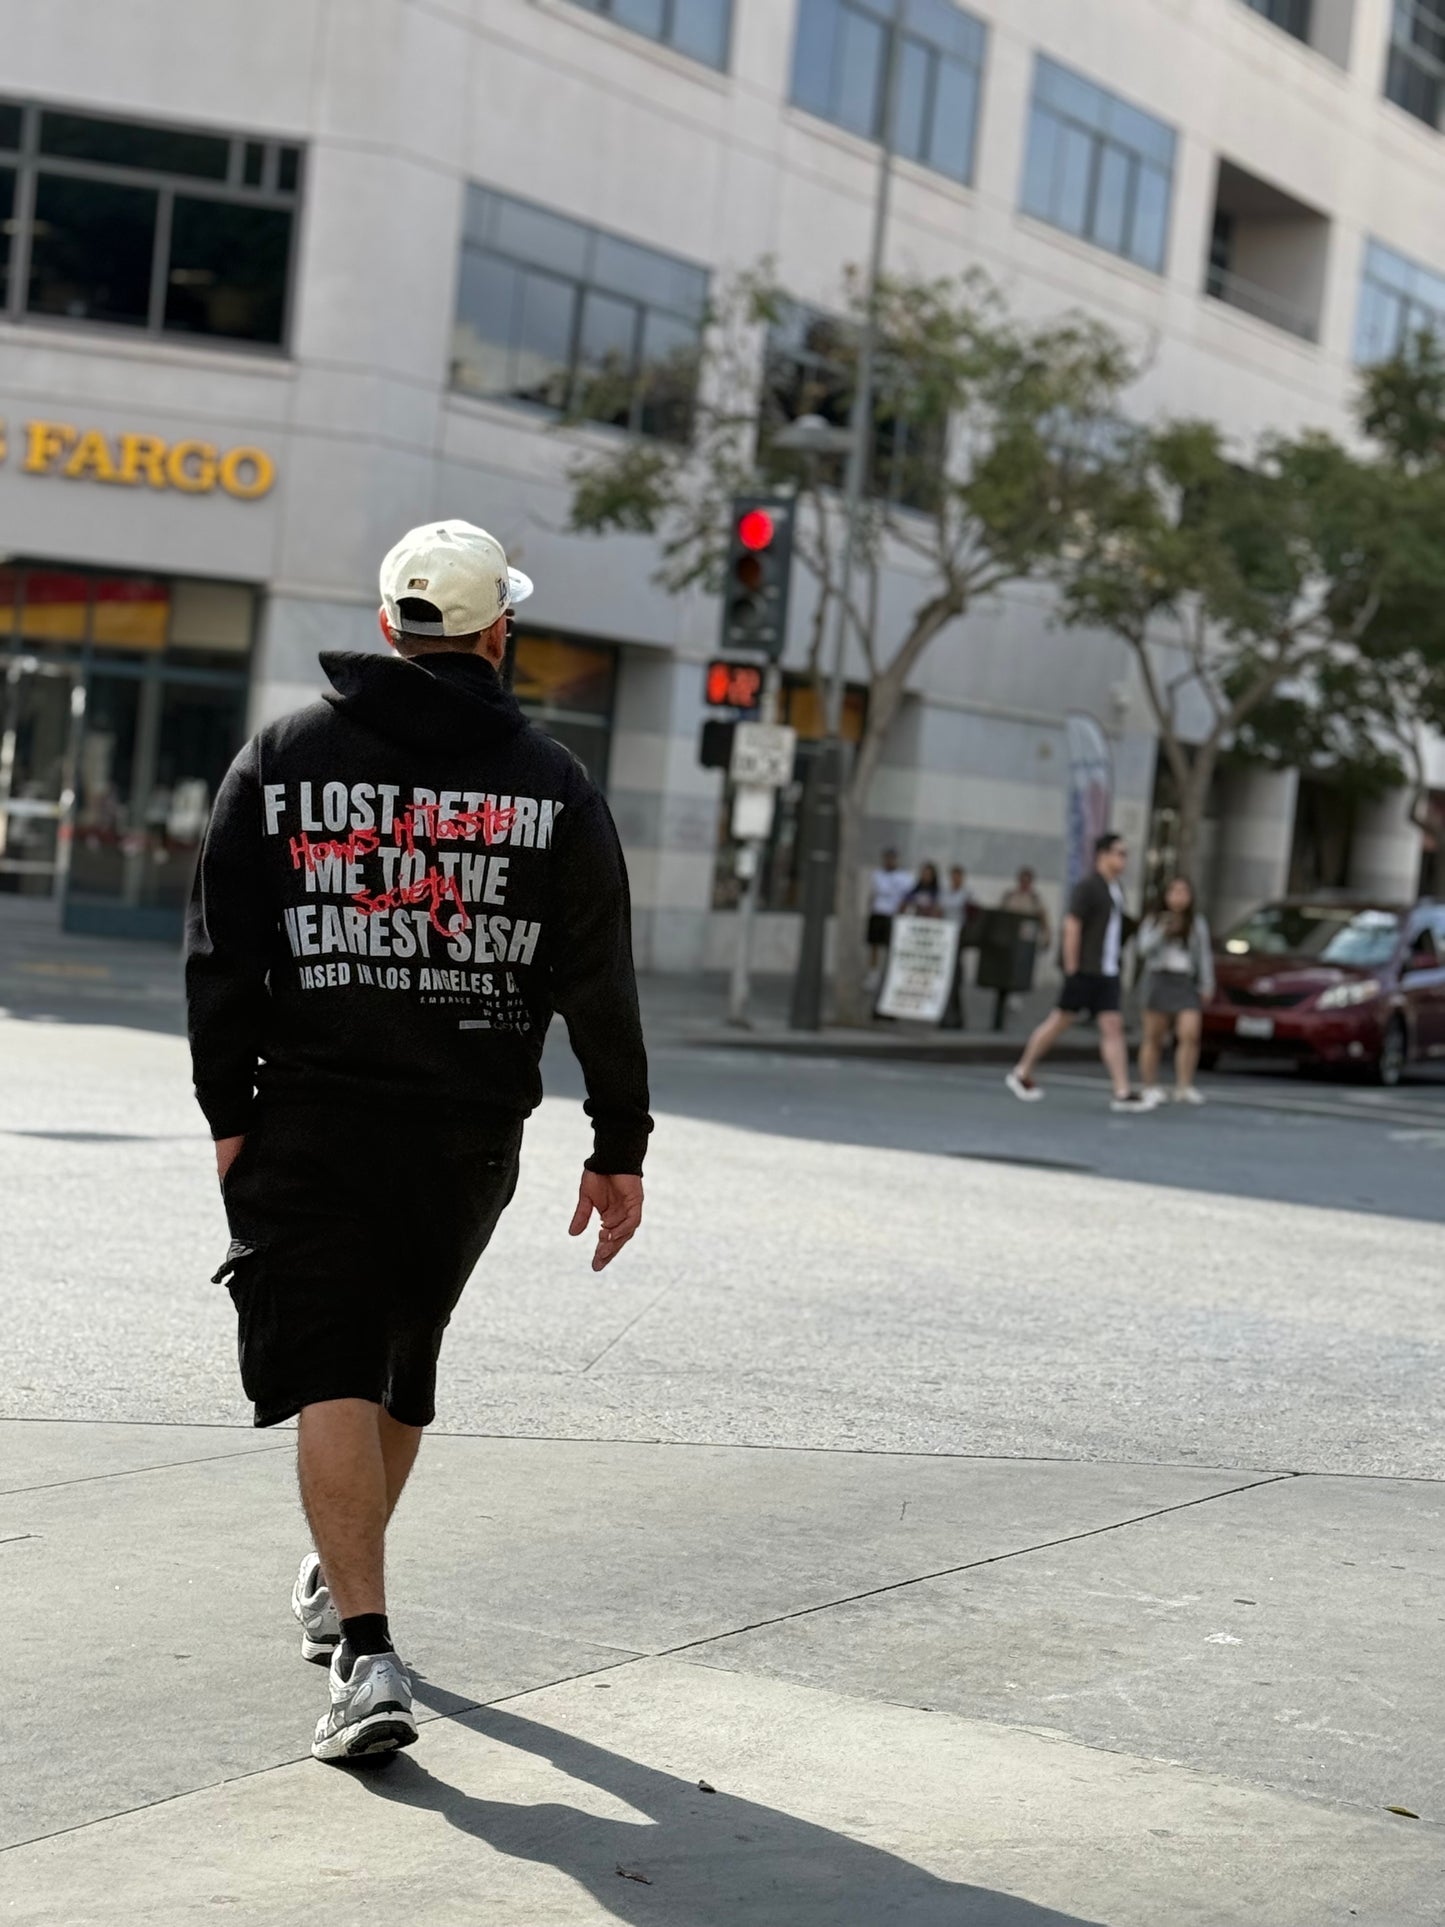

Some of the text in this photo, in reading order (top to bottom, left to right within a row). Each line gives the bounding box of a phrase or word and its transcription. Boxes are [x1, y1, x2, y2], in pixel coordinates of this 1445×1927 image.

[23, 418, 276, 500] FARGO
[263, 783, 287, 836] F
[299, 781, 401, 836] LOST
[304, 843, 511, 907] ME TO THE
[446, 913, 543, 966] SESH
[375, 966, 412, 991] LOS
